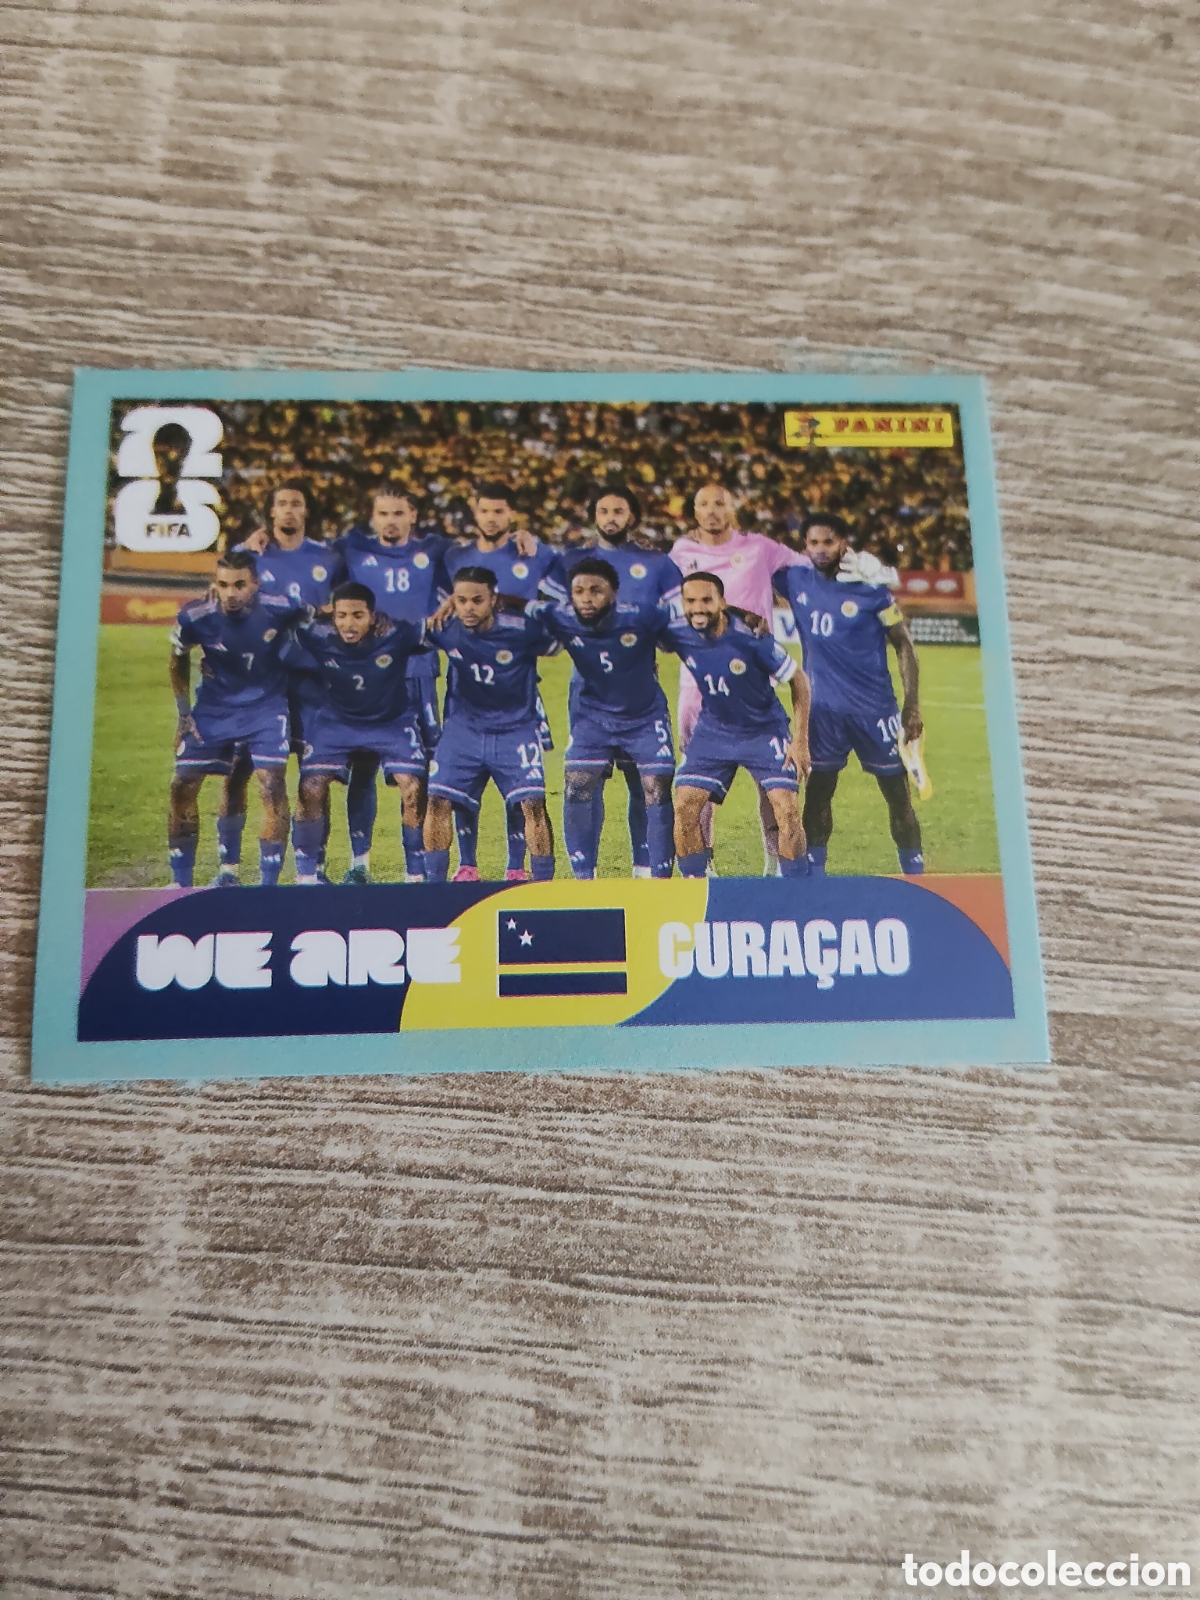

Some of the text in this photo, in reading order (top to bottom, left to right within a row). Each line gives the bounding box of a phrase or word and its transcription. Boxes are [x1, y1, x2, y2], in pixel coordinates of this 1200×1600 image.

[833, 416, 945, 433] PANINI
[146, 523, 191, 538] FIFA
[385, 568, 410, 592] 18
[810, 610, 833, 637] 10
[242, 652, 254, 670] 7
[600, 651, 613, 673] 5
[353, 674, 365, 691] 2
[470, 663, 495, 685] 12
[704, 673, 730, 697] 14
[655, 720, 667, 743] 5
[877, 715, 899, 742] 10
[517, 743, 541, 768] 12
[136, 932, 273, 991] WE
[658, 918, 911, 989] CURAÇAO
